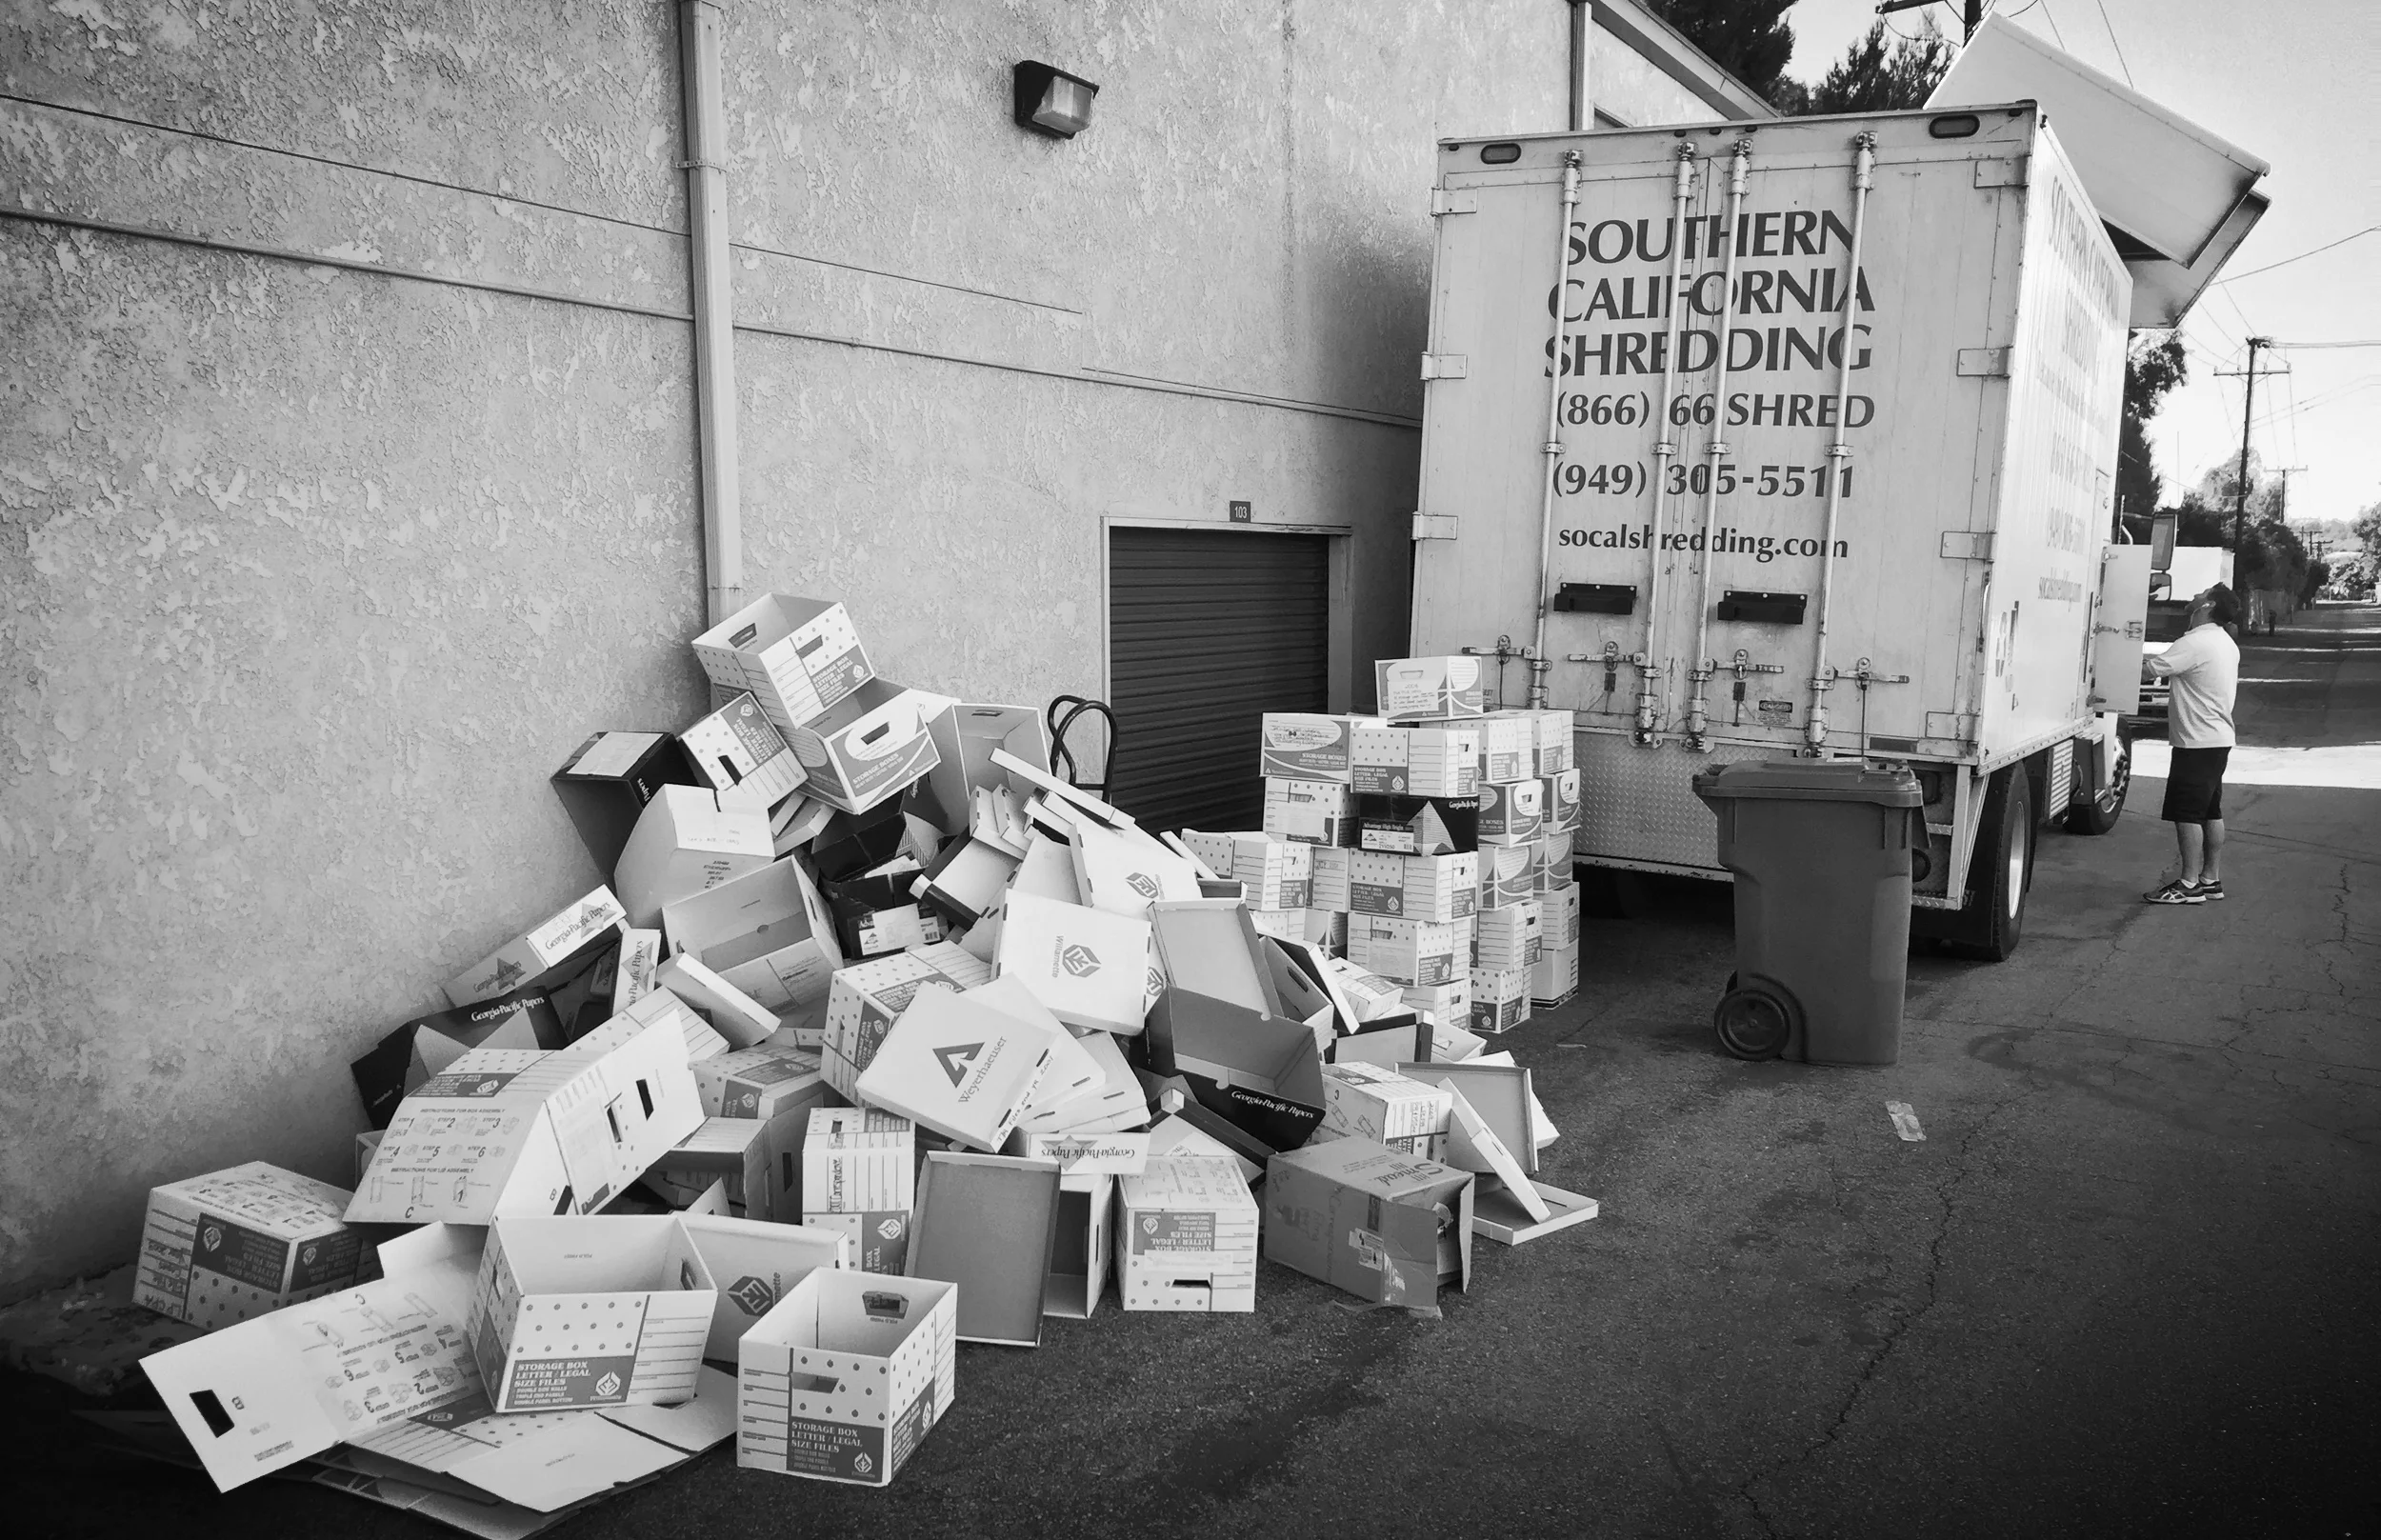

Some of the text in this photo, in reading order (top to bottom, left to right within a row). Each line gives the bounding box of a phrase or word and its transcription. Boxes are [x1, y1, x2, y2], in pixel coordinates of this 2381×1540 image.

[1567, 210, 1855, 265] SOUTHERN
[1548, 267, 1875, 323] CALIFORNIA
[1544, 324, 1872, 378] SHREDDING
[1556, 391, 1875, 429] (866) 66 SHRED
[1552, 462, 1853, 498] (949) 305-5511
[1235, 506, 1247, 519] 103
[1558, 524, 1849, 563] socalshredding.com
[836, 654, 849, 667] BOX
[852, 763, 880, 784] STORAGE
[545, 915, 590, 950] Georgia-Pacific
[588, 902, 610, 920] Papers
[632, 940, 643, 970] Papers
[1051, 935, 1064, 978] Willamette
[470, 996, 545, 1022] Georgia-Pacific Papers
[958, 1036, 1007, 1103] Weyerhaeuser
[1231, 1090, 1313, 1118] Georgia-Pacific Papers
[447, 1117, 456, 1128] 2
[492, 1117, 501, 1128] 3
[432, 1146, 441, 1157] 5
[478, 1146, 486, 1157] 6
[1041, 1146, 1135, 1160] Georgia-Pacific Papers
[1374, 1163, 1444, 1187] Smead
[405, 1207, 414, 1218] C
[515, 1370, 552, 1379] LETTER
[559, 1370, 591, 1378] LEGAL
[517, 1362, 565, 1371] STORAGE
[538, 1378, 566, 1387] FILES
[791, 1421, 858, 1437] STORAGE BOX
[791, 1430, 826, 1443] LETTER
[832, 1436, 863, 1448] LEGAL
[791, 1439, 840, 1452] SIZE FILES
